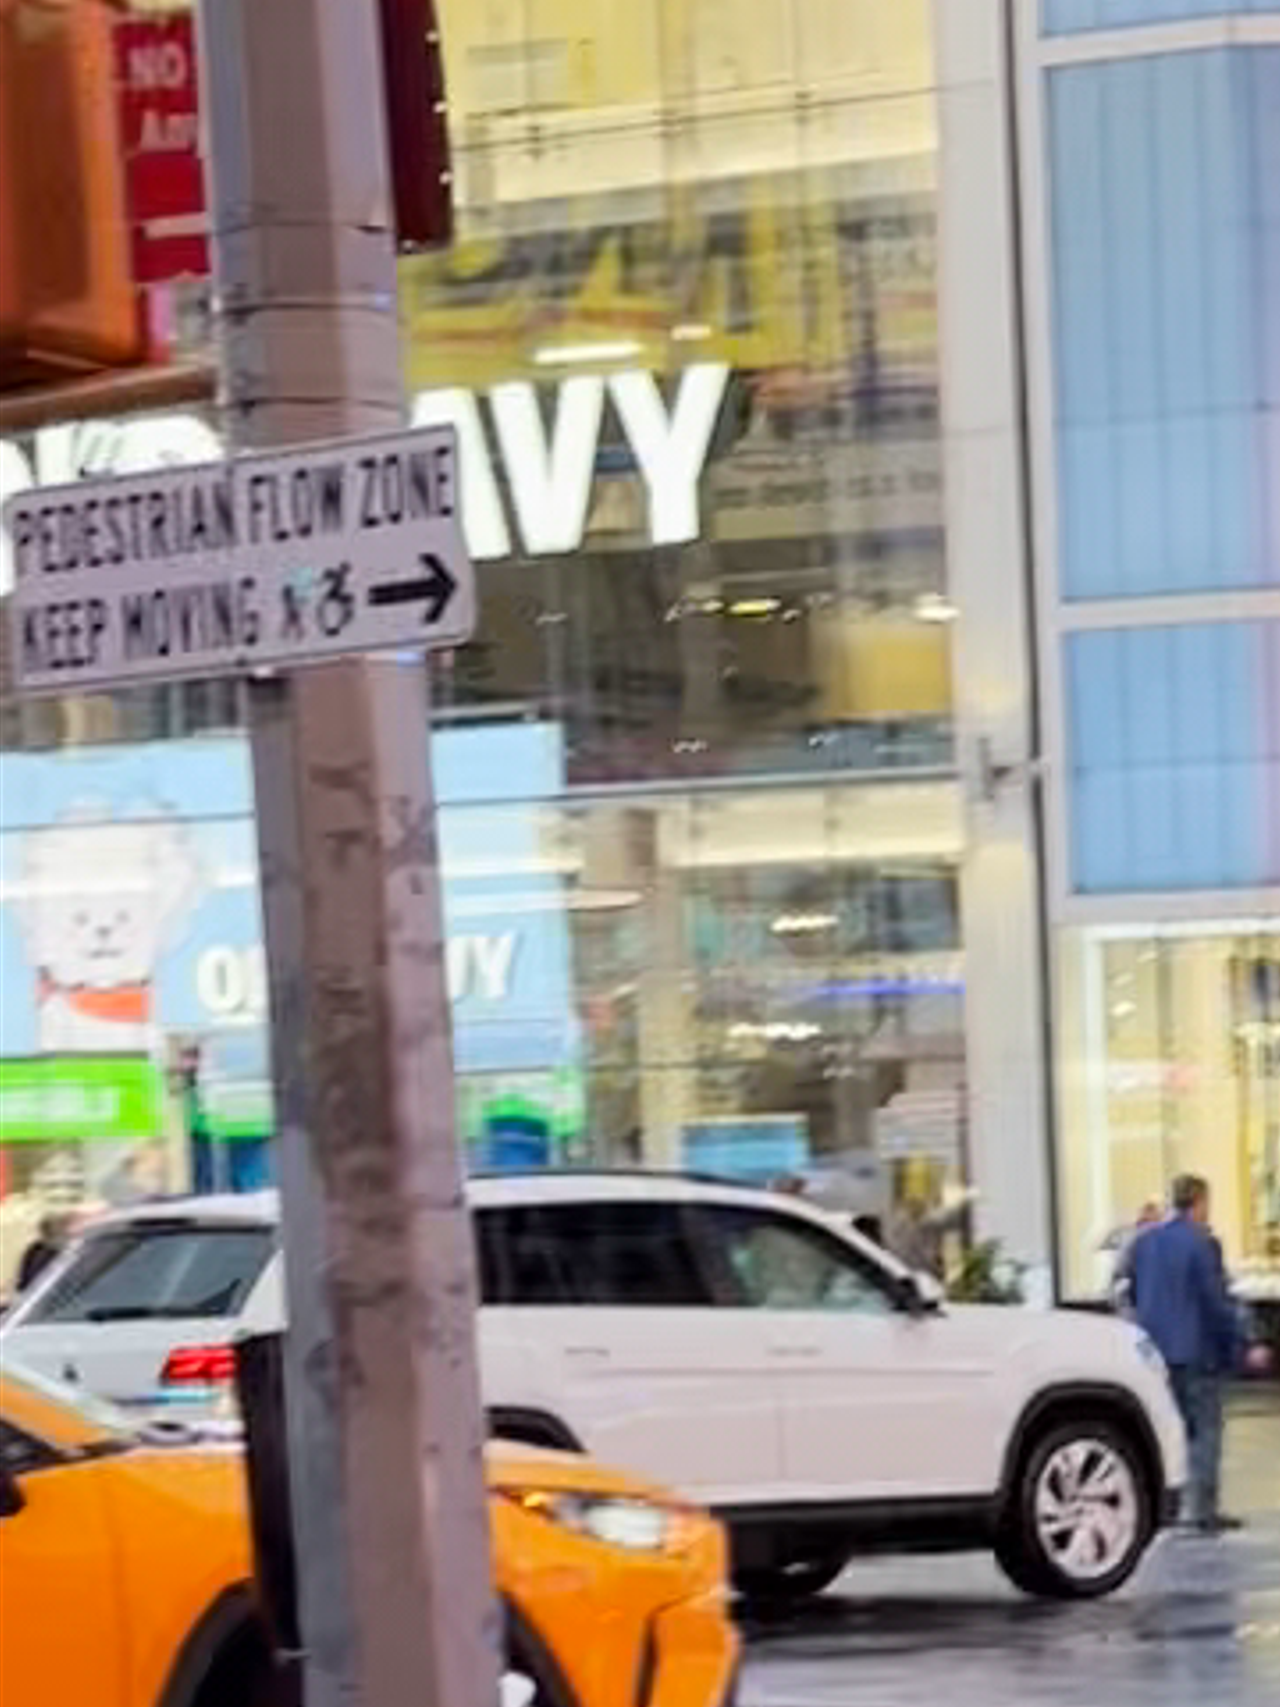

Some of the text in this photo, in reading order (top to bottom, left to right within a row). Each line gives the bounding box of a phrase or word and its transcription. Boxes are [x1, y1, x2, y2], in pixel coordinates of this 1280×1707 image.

[128, 43, 188, 90] NO
[14, 445, 452, 577] PEDESTRIAN FLOW ZONE
[402, 361, 730, 562] AVY
[22, 576, 257, 675] KEEP MOVING
